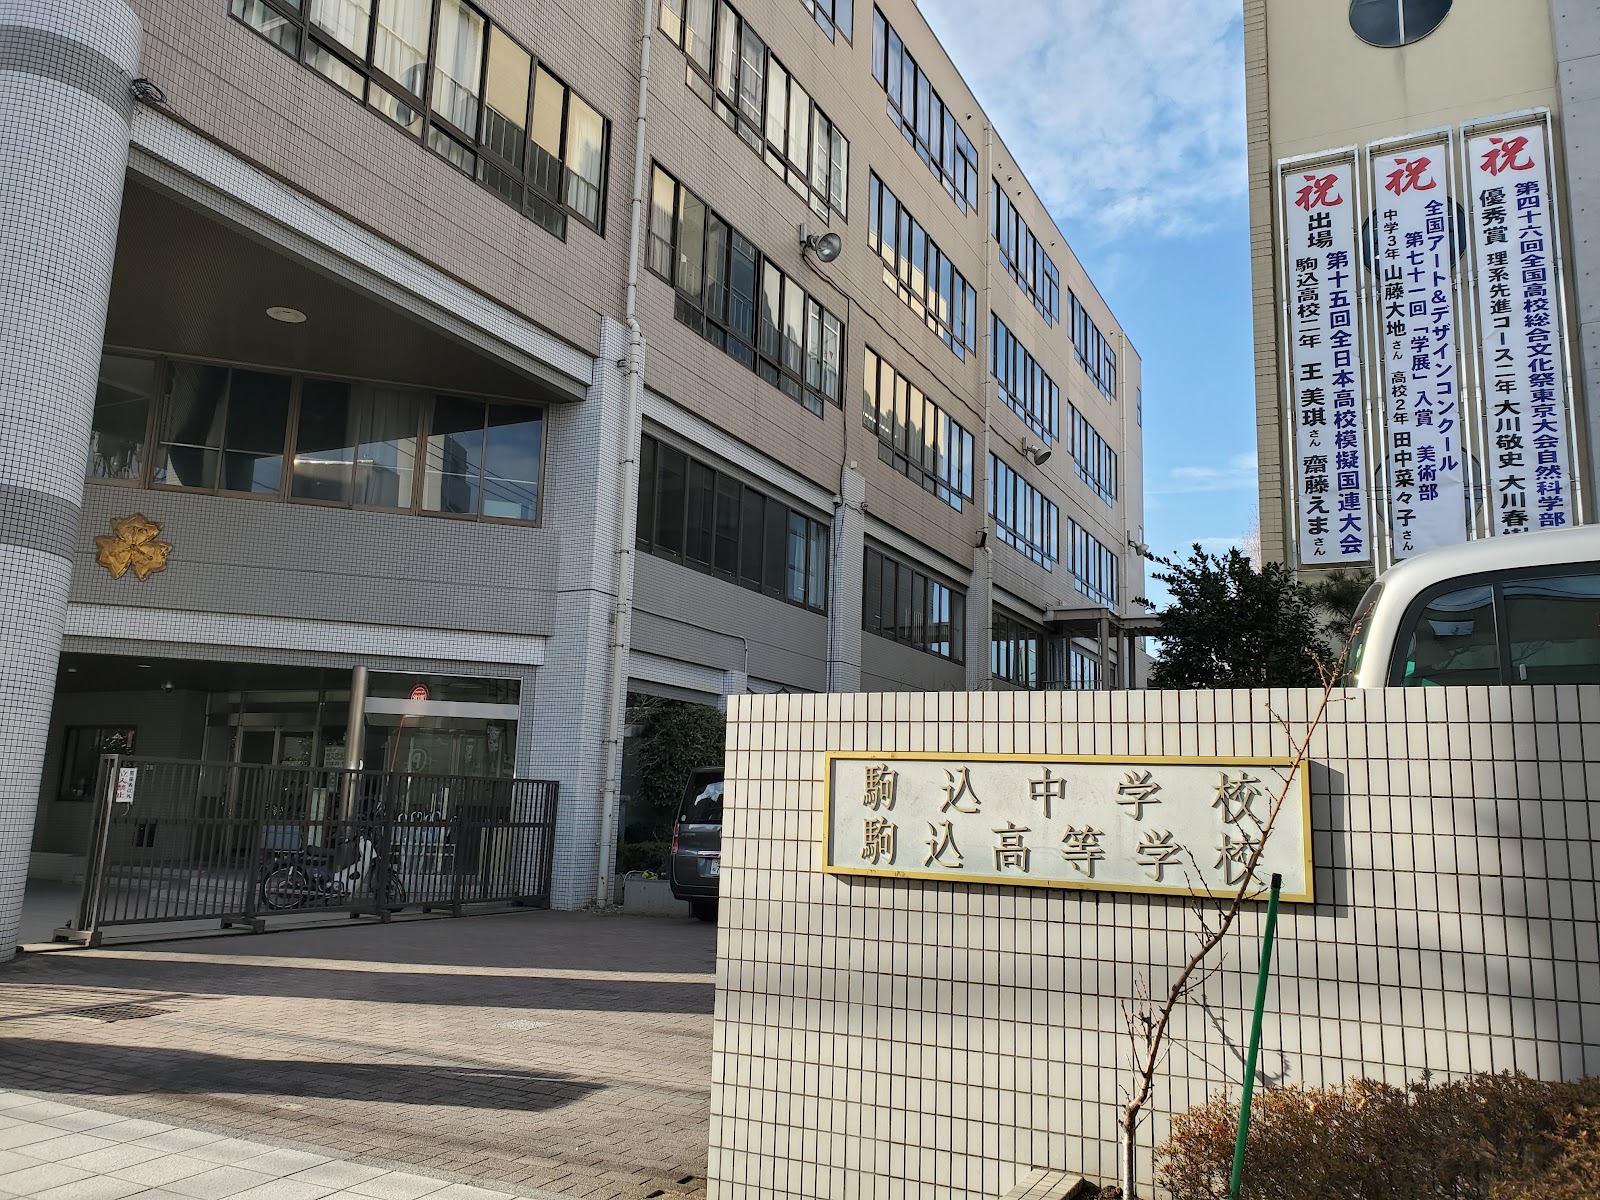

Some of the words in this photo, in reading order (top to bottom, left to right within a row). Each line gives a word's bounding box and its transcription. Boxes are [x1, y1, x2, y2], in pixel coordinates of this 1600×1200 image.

[1385, 157, 1436, 196] 祝
[1481, 137, 1535, 176] 祝
[1295, 174, 1343, 211] 祝
[1479, 187, 1509, 246] 優秀賞
[1307, 211, 1333, 249] 出場
[1326, 251, 1363, 555] 第十五回全日本高校模擬国連大会
[1417, 445, 1439, 502] 美術部
[862, 763, 1264, 824] 駒込中学校
[861, 816, 1266, 886] 駒込高等学校
